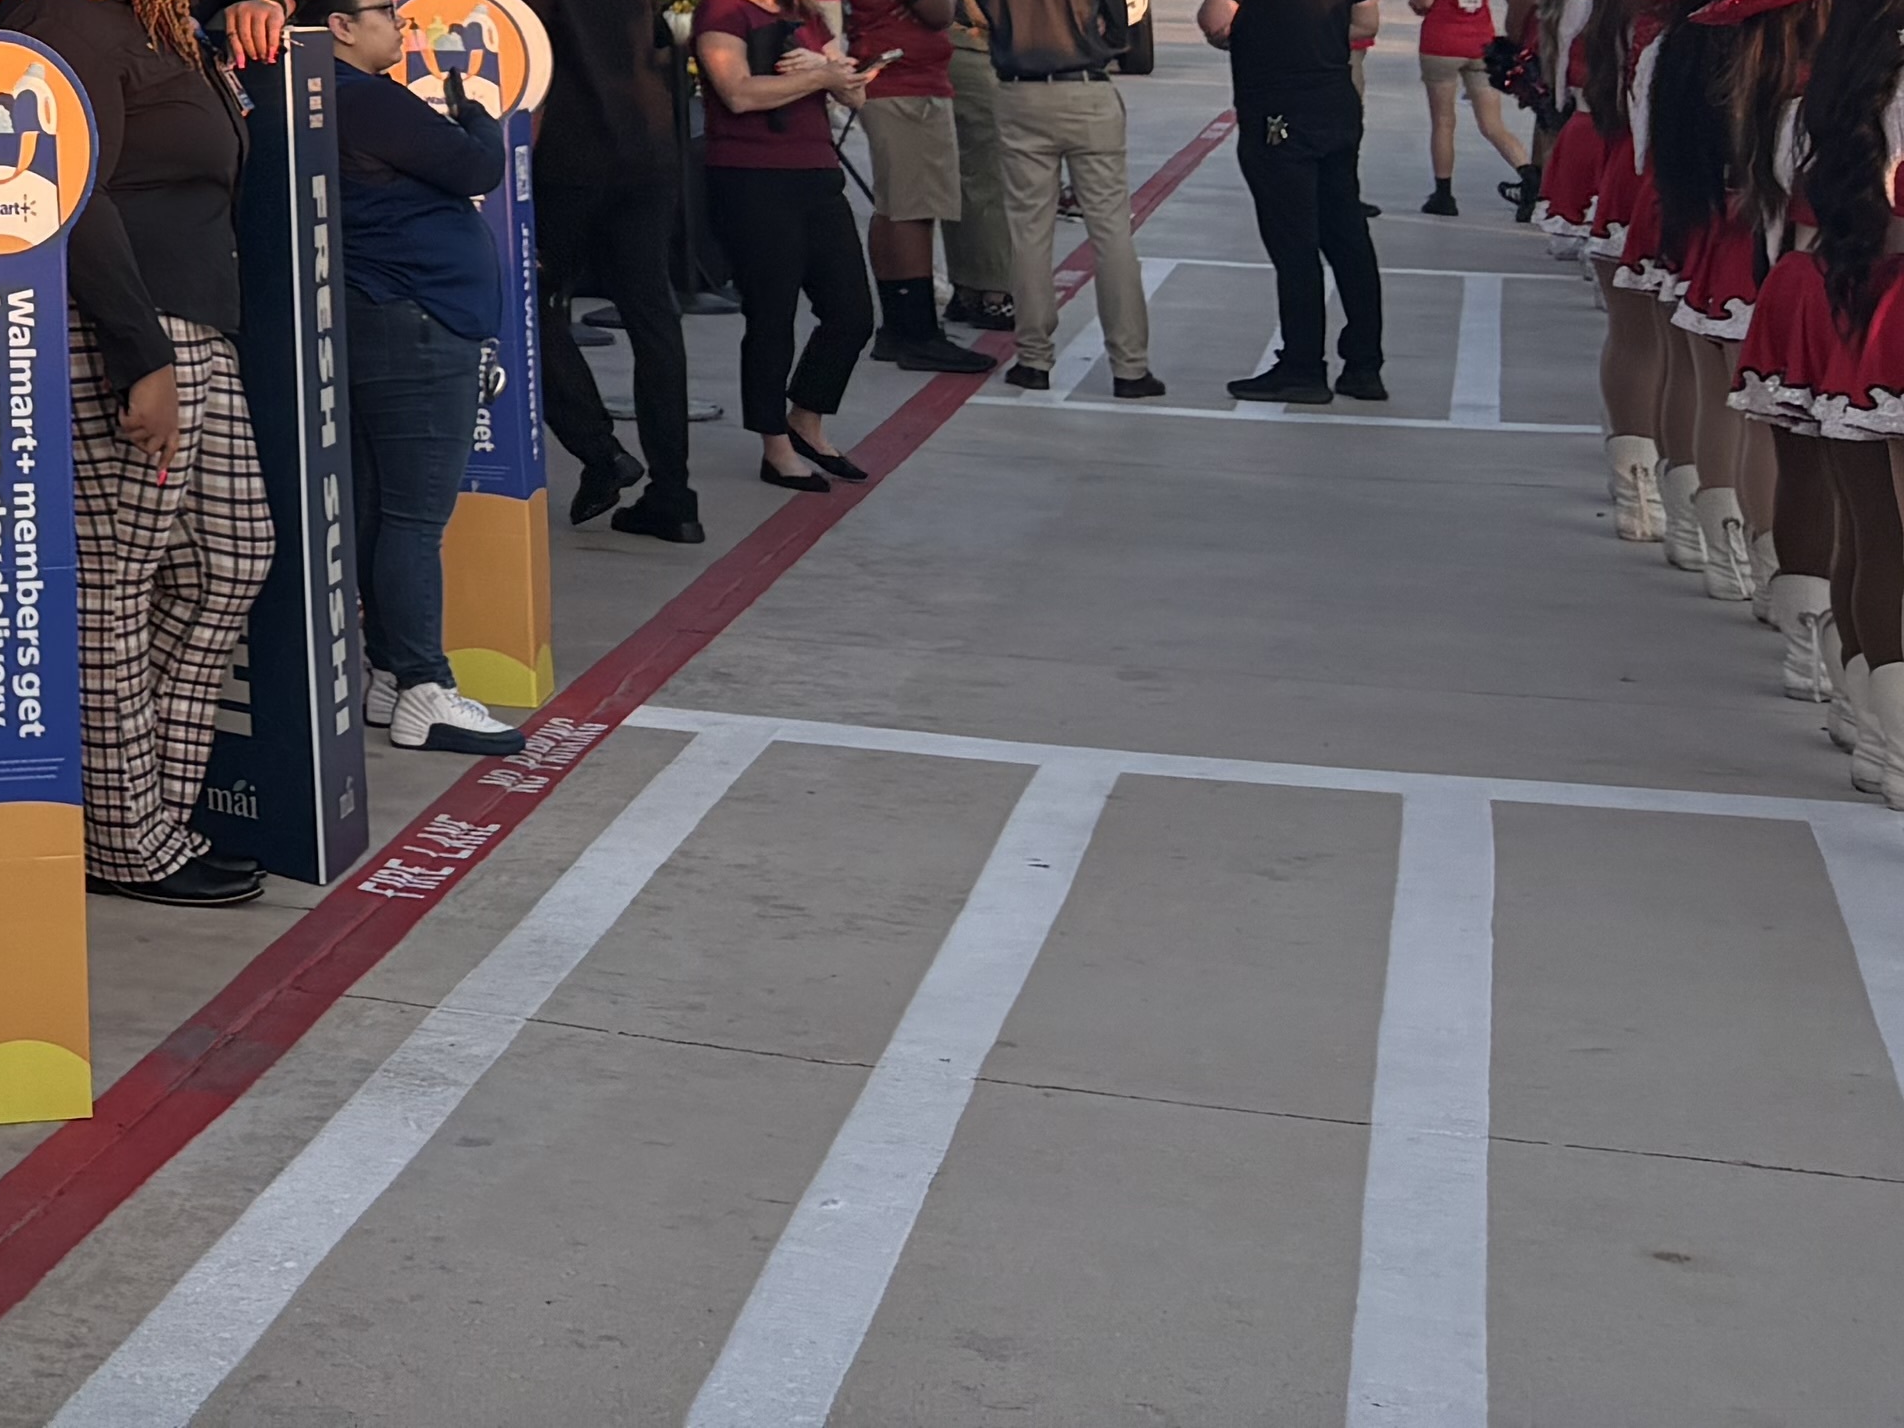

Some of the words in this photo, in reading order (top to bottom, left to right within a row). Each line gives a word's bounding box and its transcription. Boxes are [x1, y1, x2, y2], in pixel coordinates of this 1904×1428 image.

[311, 174, 337, 448] FRESH
[7, 288, 38, 475] Walmart+
[13, 482, 44, 667] members
[323, 473, 351, 736] SUSHI
[12, 670, 46, 739] get
[402, 813, 502, 860] LANE
[477, 768, 550, 794] NO
[357, 858, 456, 899] FIRE
